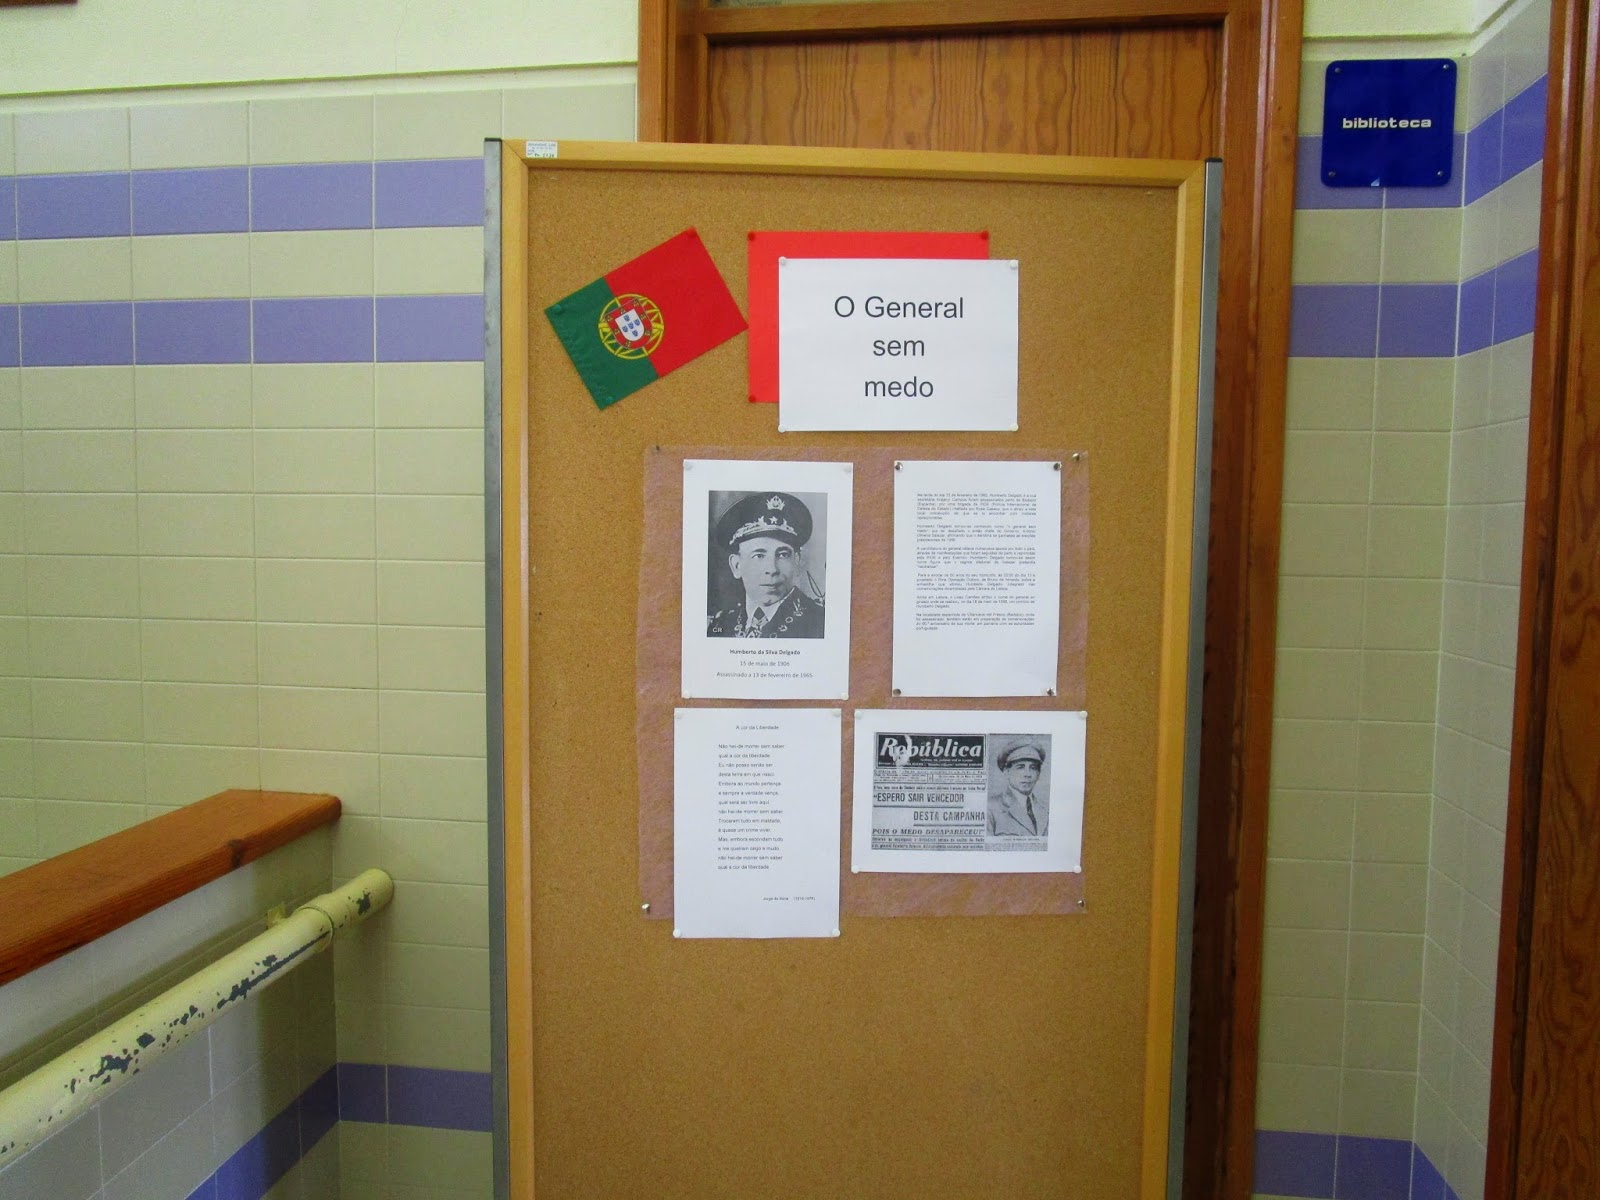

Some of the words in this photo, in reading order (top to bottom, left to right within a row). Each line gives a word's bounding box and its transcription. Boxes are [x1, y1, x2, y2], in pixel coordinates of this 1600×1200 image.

[1342, 117, 1432, 129] biblioteca
[834, 295, 855, 318] O
[864, 295, 964, 318] General
[872, 339, 925, 356] sem
[864, 376, 934, 397] medo
[908, 792, 925, 803] SAIR
[926, 792, 964, 803] VENCEDOR
[914, 811, 940, 822] DESTA
[942, 811, 986, 822] CAMPANHA
